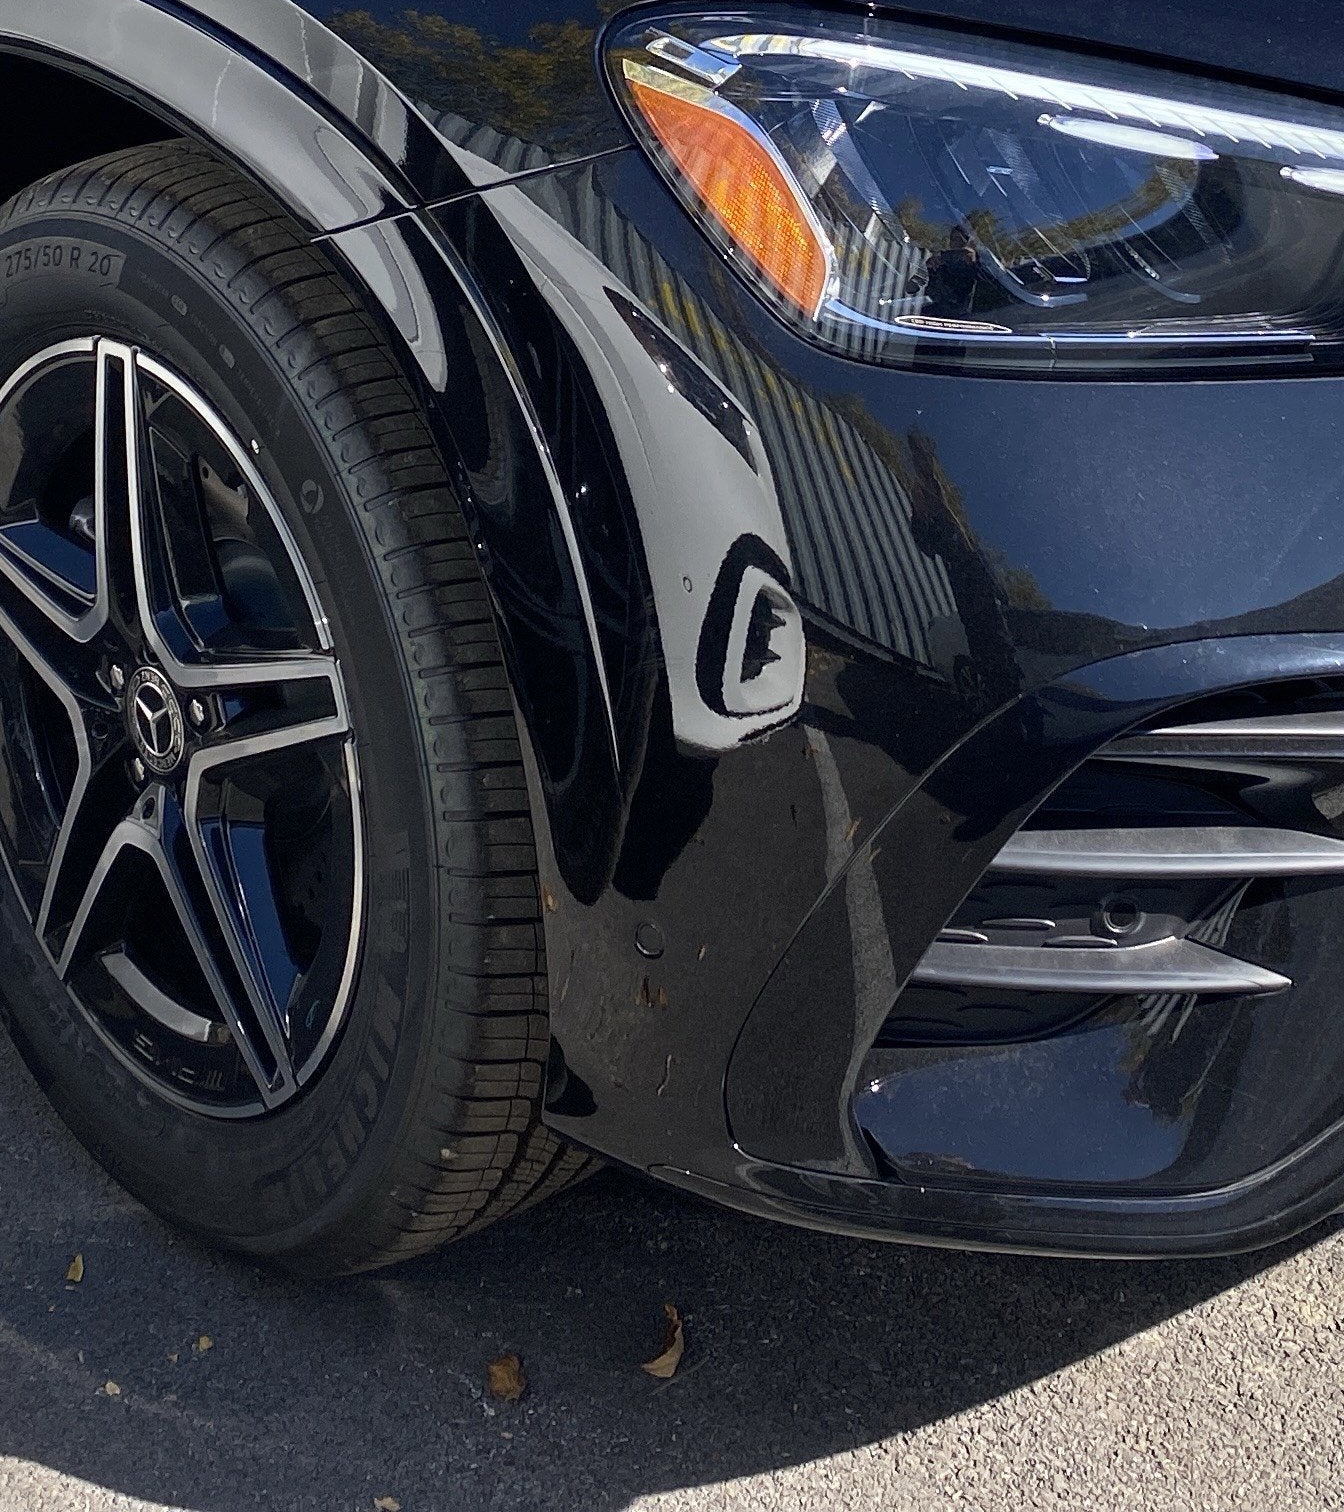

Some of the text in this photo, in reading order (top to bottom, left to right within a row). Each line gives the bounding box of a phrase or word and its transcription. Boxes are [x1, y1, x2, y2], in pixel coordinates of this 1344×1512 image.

[5, 245, 111, 278] 275/50 R 20
